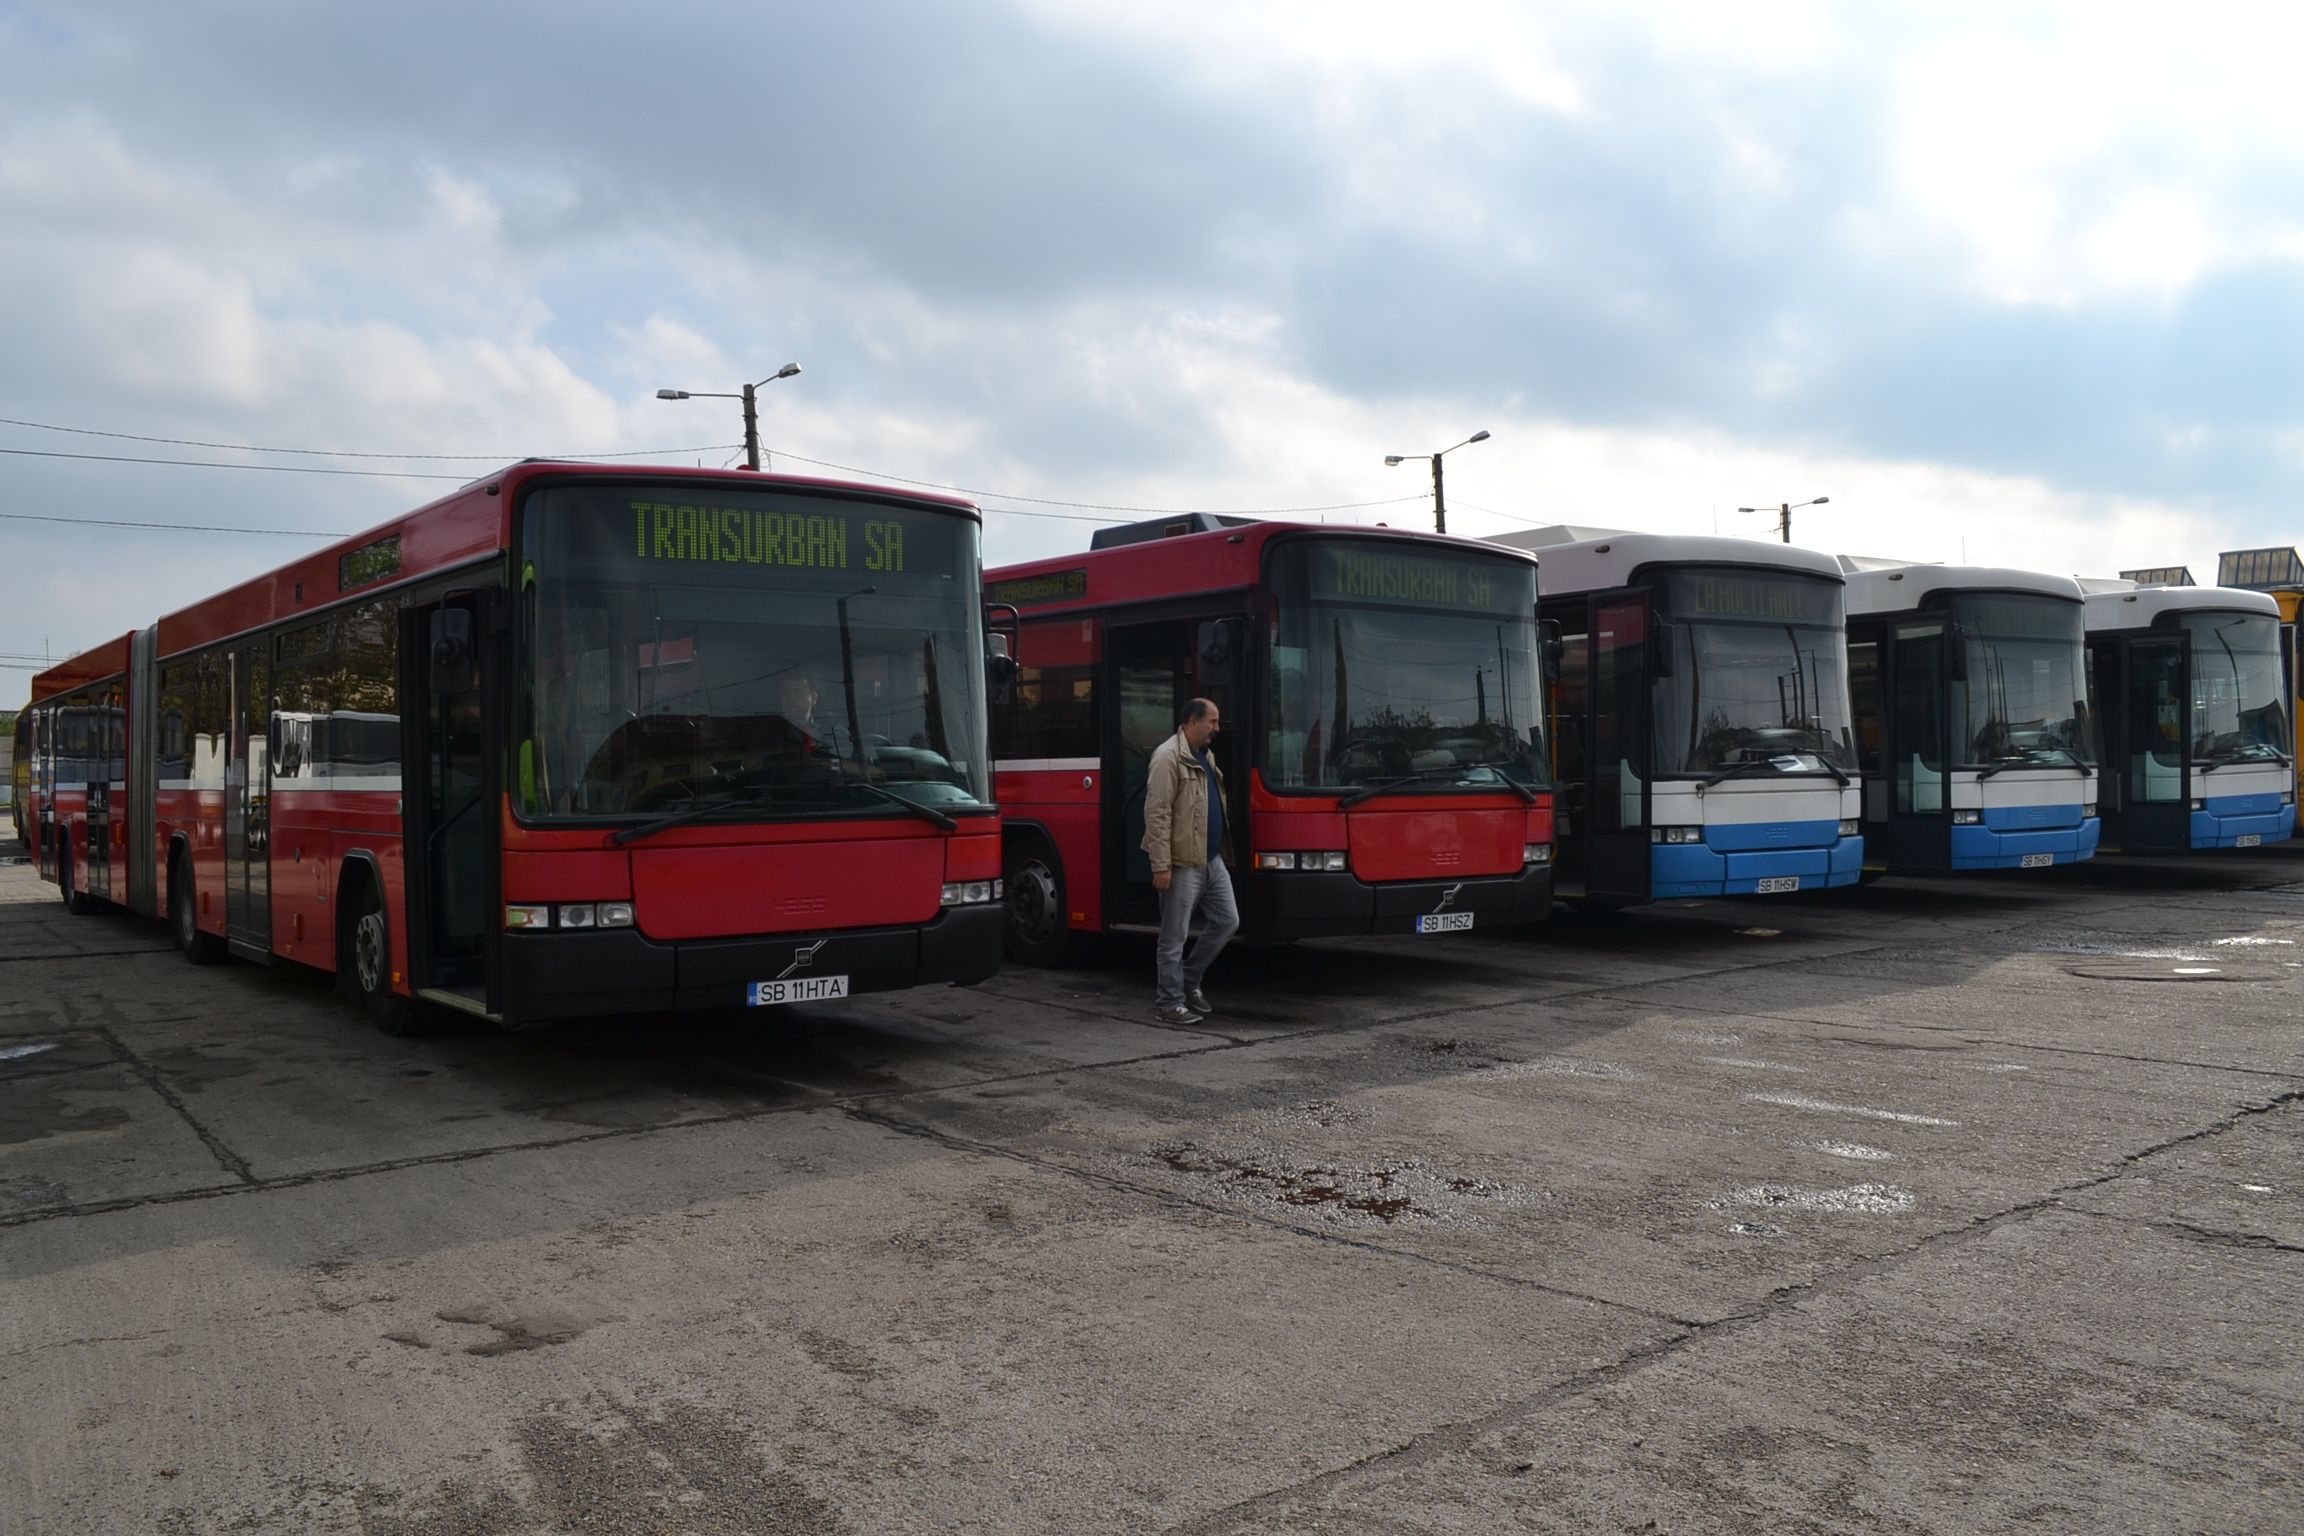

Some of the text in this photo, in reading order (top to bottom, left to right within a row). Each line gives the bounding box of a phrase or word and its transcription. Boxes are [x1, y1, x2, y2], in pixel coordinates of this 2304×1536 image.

[630, 502, 903, 571] TRANSURBAN SA
[994, 573, 1084, 602] TRANSURBAN SA
[1336, 551, 1490, 607] TRANSURBAN SA
[1760, 879, 1772, 892] SB
[1424, 916, 1438, 931] SB
[1442, 914, 1471, 930] 11HSZ
[761, 983, 786, 1002] SB
[792, 979, 842, 999] 11HTA
